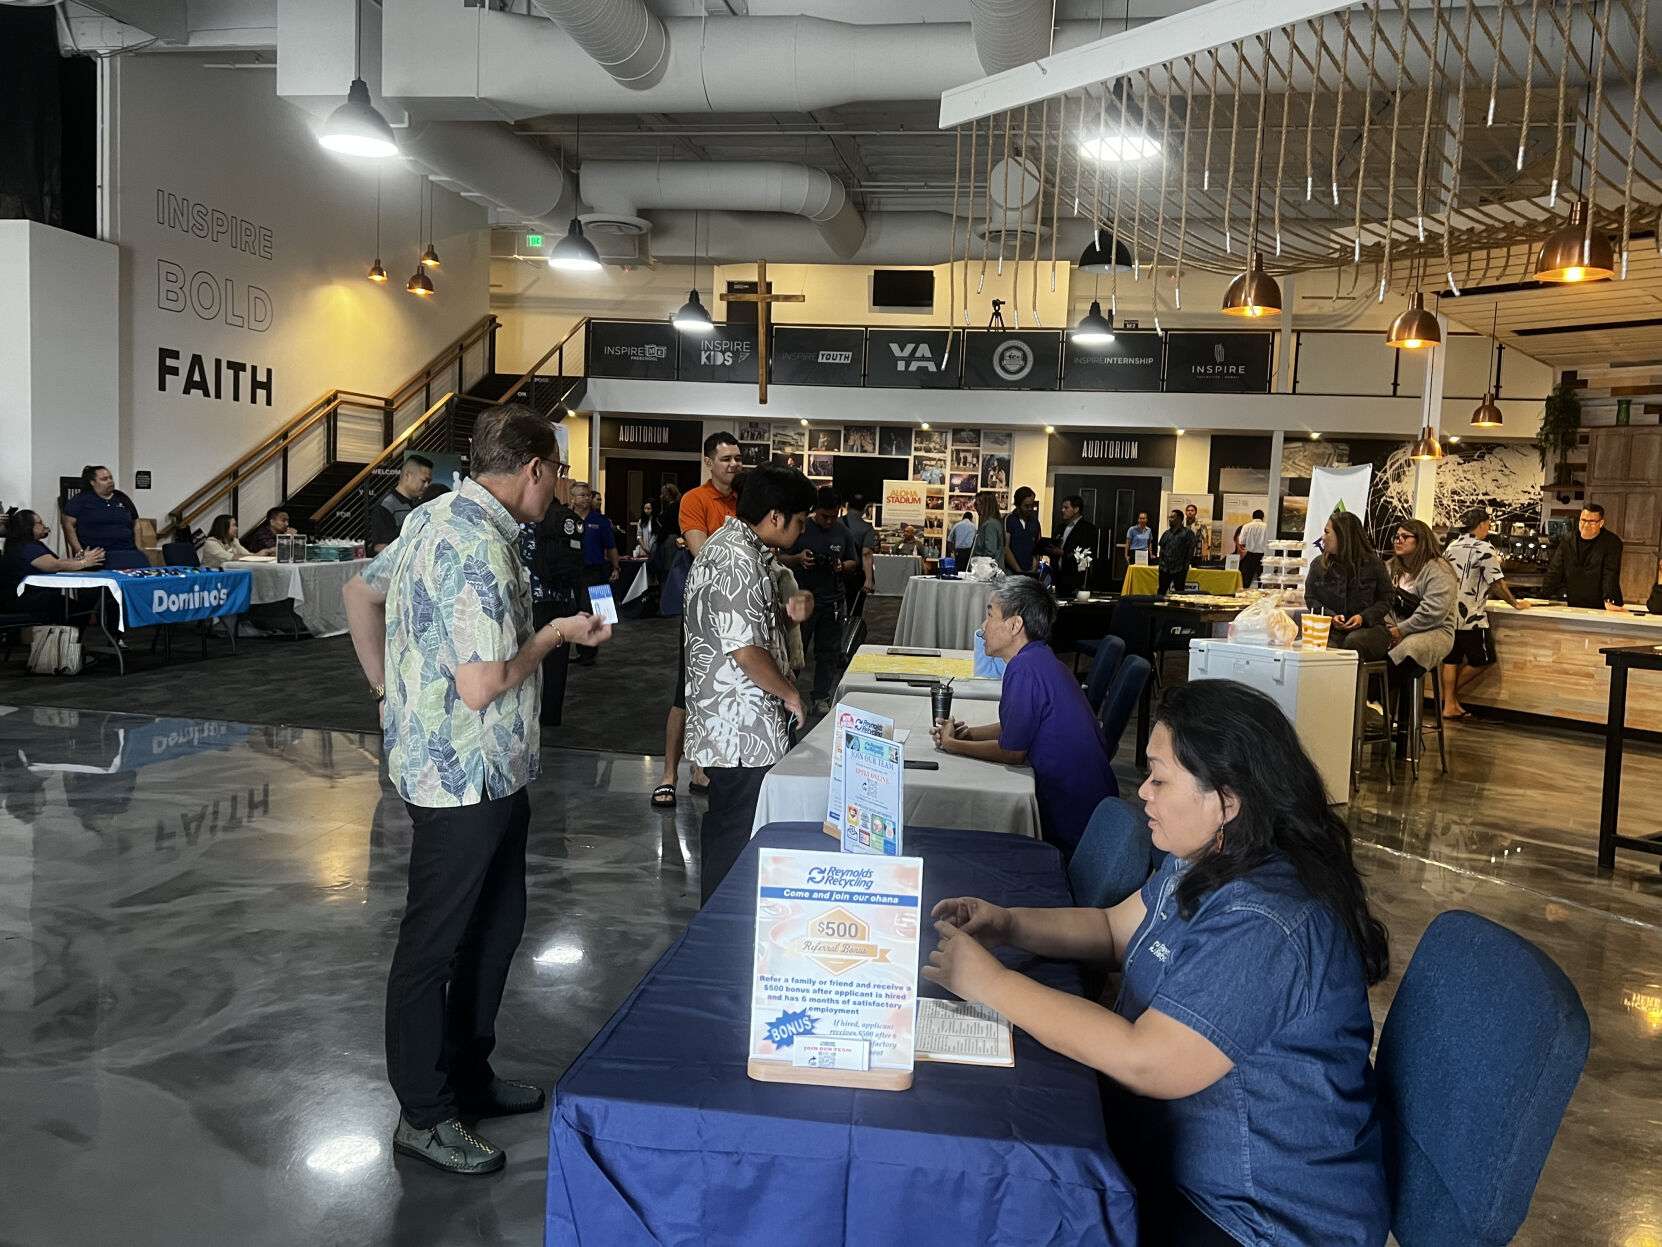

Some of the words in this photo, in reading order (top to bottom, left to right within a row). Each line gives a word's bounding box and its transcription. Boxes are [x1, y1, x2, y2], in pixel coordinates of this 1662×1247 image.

[156, 189, 273, 260] INSPIRE
[157, 259, 273, 332] BOLD
[604, 346, 644, 356] INSPIRE
[701, 340, 751, 352] INSPIRE
[701, 351, 733, 366] KIDS
[782, 352, 818, 361] INSPIRE
[820, 352, 851, 361] YOUTH
[1192, 365, 1246, 374] INSPIRE
[158, 347, 273, 407] FAITH
[619, 425, 669, 444] AUDITORIUM
[1082, 440, 1138, 459] AUDITORIUM
[886, 496, 921, 504] STADIUM
[890, 489, 918, 497] ALOHA
[152, 583, 228, 613] Domino's
[863, 719, 883, 731] Reynolds
[850, 751, 864, 761] JOIN
[864, 754, 877, 764] OUR
[878, 758, 894, 770] TEAM
[855, 767, 870, 777] APPLY
[870, 772, 889, 784] ONLINE
[826, 866, 874, 880] Reynolds
[824, 877, 874, 890] Recycling
[783, 889, 810, 898] Come
[812, 890, 830, 899] and
[831, 891, 850, 901] join
[852, 894, 869, 902] our
[870, 895, 899, 904] ohana
[817, 921, 859, 938] $500
[802, 941, 839, 953] Referral
[840, 943, 868, 954] Bonus
[760, 975, 782, 983] Refer
[791, 977, 817, 986] family
[829, 979, 854, 988] friend
[855, 981, 871, 989] and
[872, 983, 904, 991] receive
[763, 984, 784, 992] $500
[785, 985, 810, 994] bonus
[834, 989, 873, 998] applicant
[875, 991, 883, 999] is
[885, 992, 907, 1000] hired
[808, 997, 840, 1005] months
[852, 999, 902, 1009] satisfactory
[808, 1006, 859, 1015] employment
[769, 1016, 813, 1042] BONUS
[833, 1019, 840, 1027] If
[840, 1020, 861, 1029] hired,
[861, 1022, 894, 1031] applicant
[858, 1030, 874, 1038] $500
[874, 1031, 891, 1040] after
